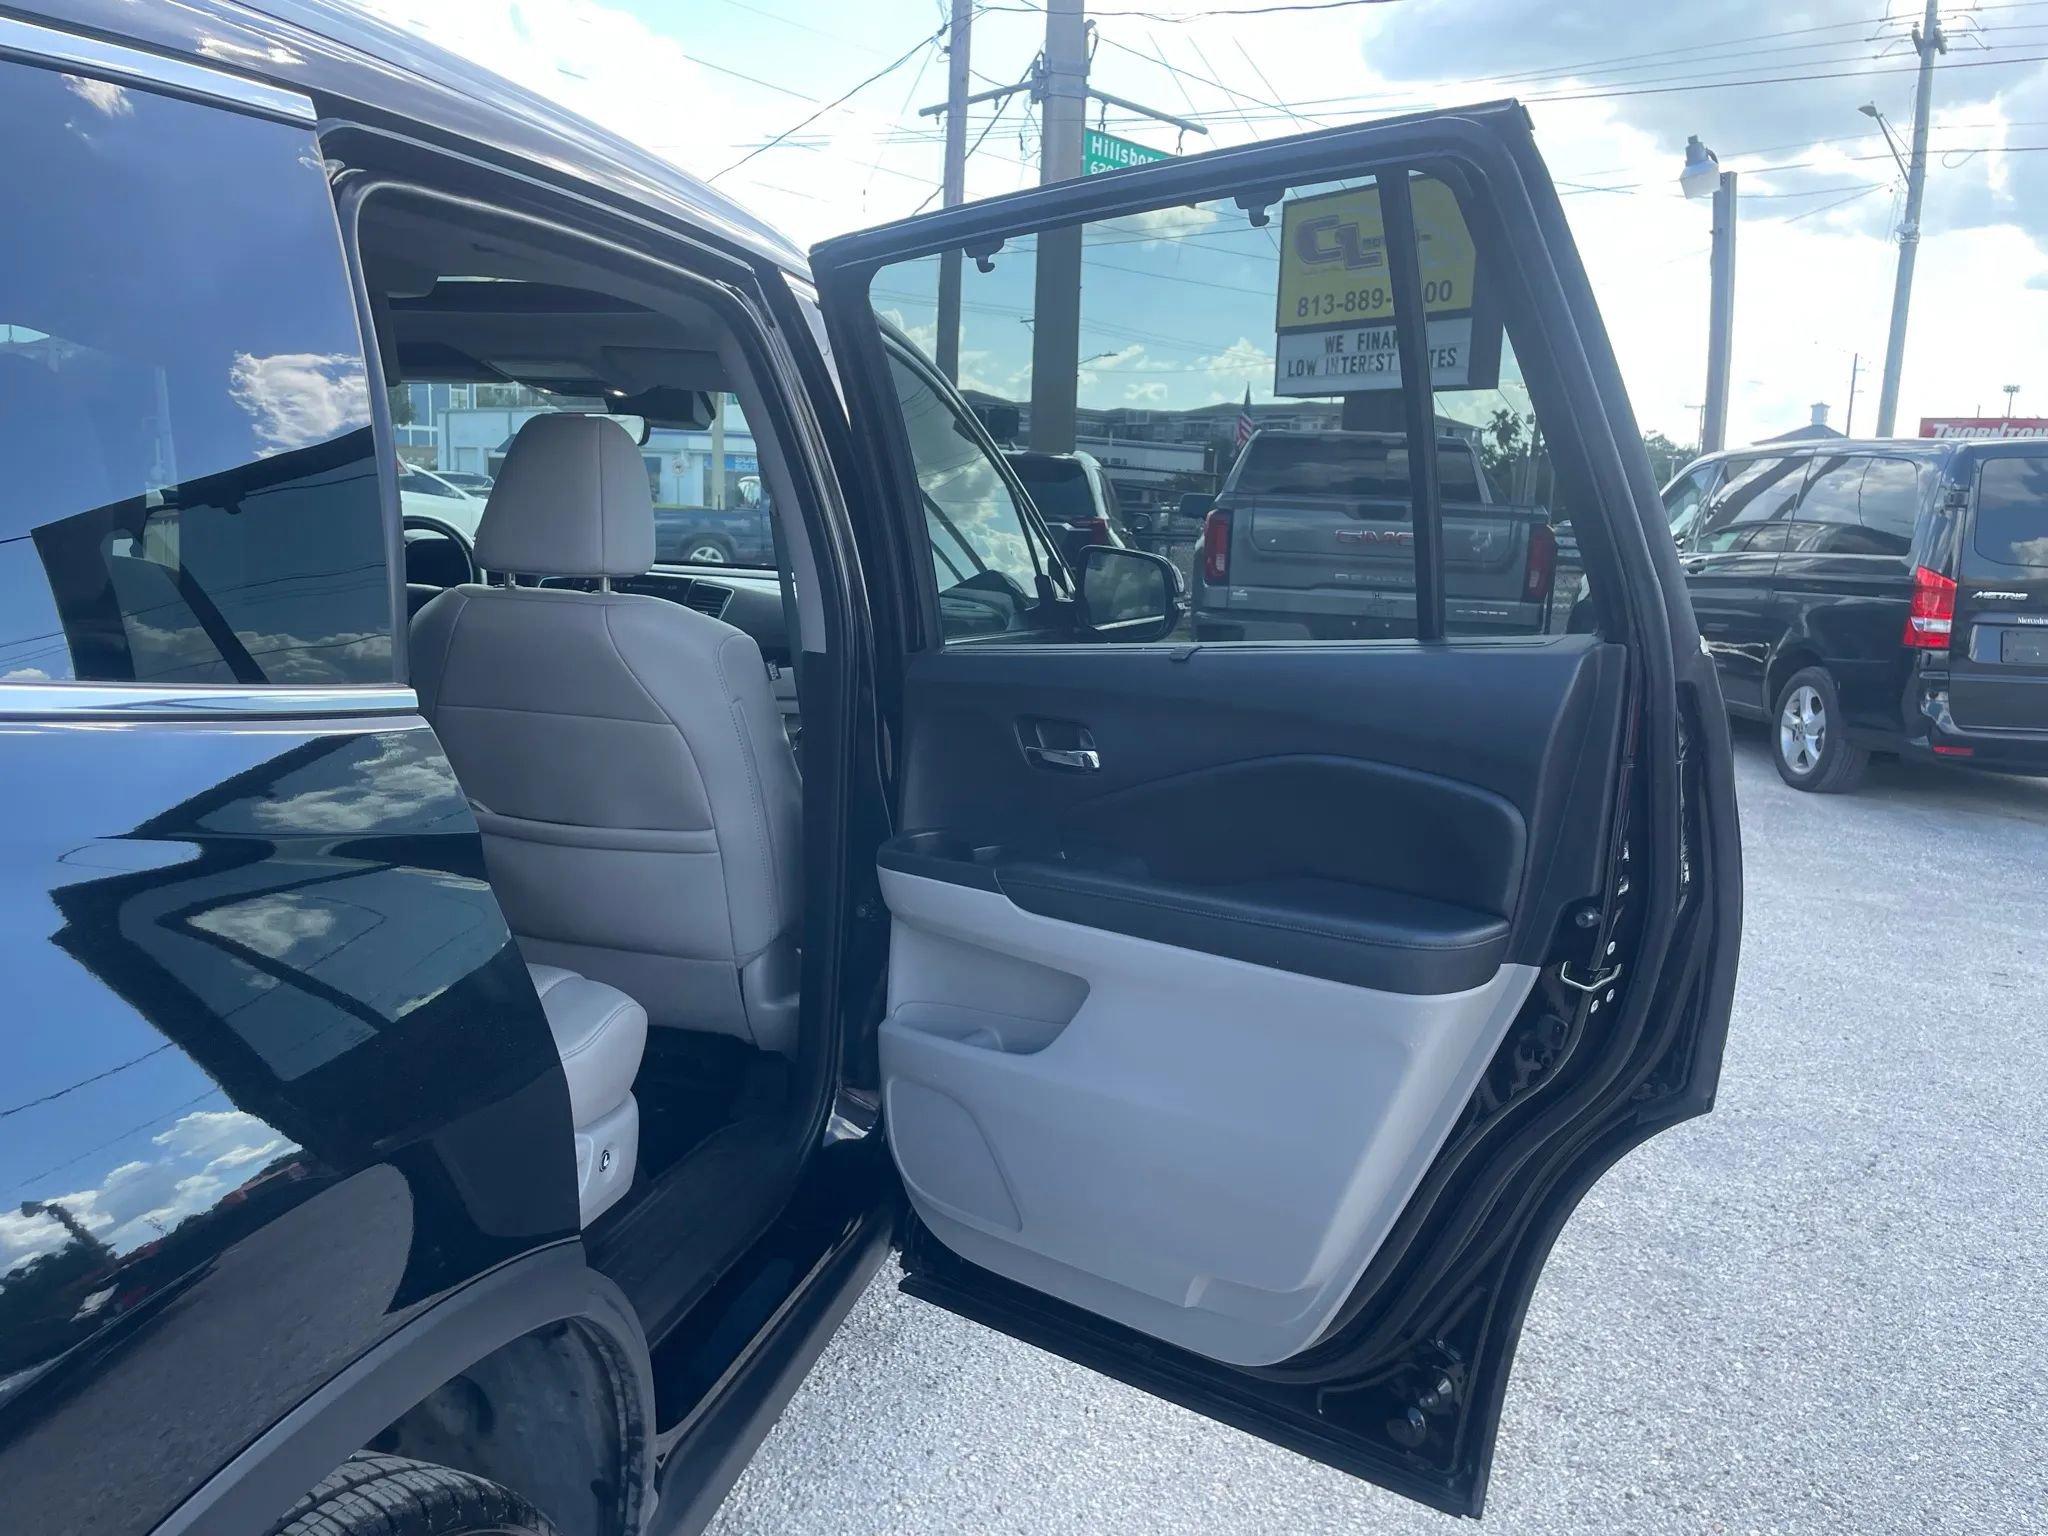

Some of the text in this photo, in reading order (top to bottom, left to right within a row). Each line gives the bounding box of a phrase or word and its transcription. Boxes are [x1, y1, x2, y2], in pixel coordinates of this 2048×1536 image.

[1296, 279, 1454, 318] 813-889-00
[1324, 334, 1345, 353] WE
[1286, 359, 1317, 378] LOW
[1324, 352, 1396, 376] INTEREST
[1971, 591, 2029, 601] METRIS
